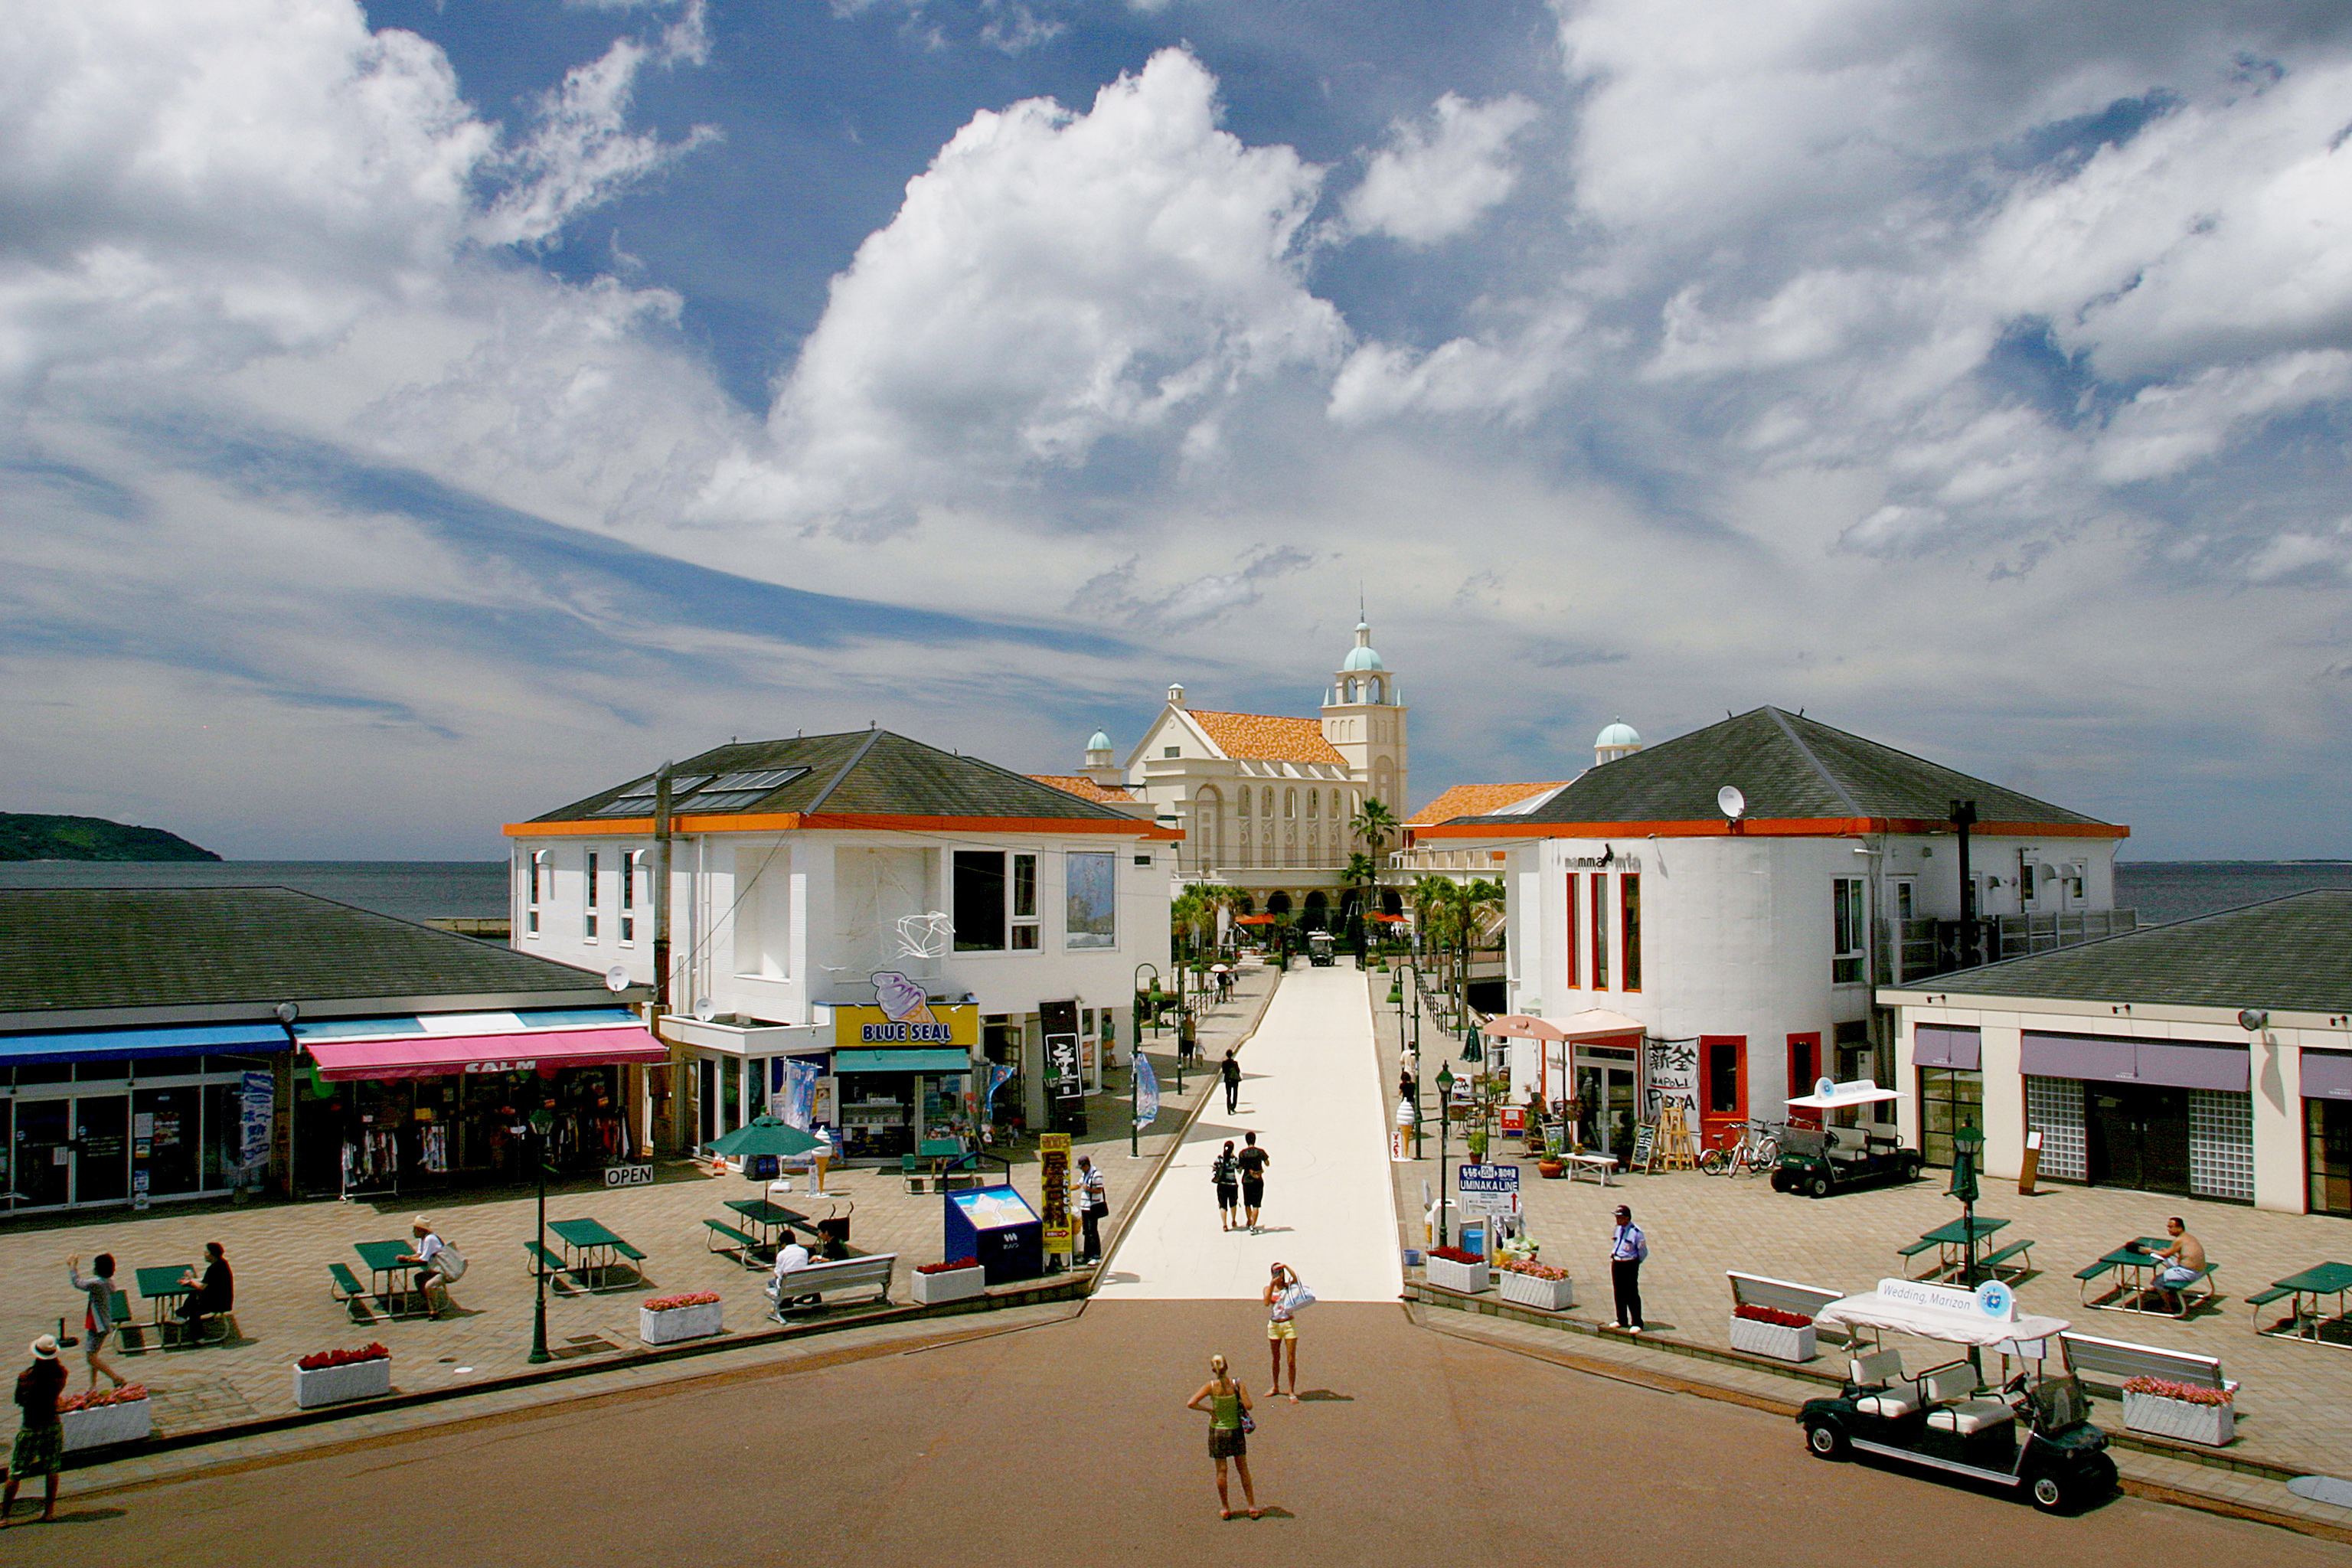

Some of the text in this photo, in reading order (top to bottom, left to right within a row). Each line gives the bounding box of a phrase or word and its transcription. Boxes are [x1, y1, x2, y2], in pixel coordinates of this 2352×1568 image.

[862, 1023, 952, 1042] BLUE SEAL
[465, 1060, 537, 1073] CALM
[1648, 1044, 1697, 1071] 薪釜
[1651, 1076, 1688, 1087] NAPOLI
[1647, 1088, 1697, 1111] PZA
[608, 1167, 652, 1184] OPEN
[1460, 1181, 1517, 1191] UMINAKA LINE
[1883, 1284, 1927, 1305] Wedding,
[1930, 1292, 1971, 1310] Marizon
